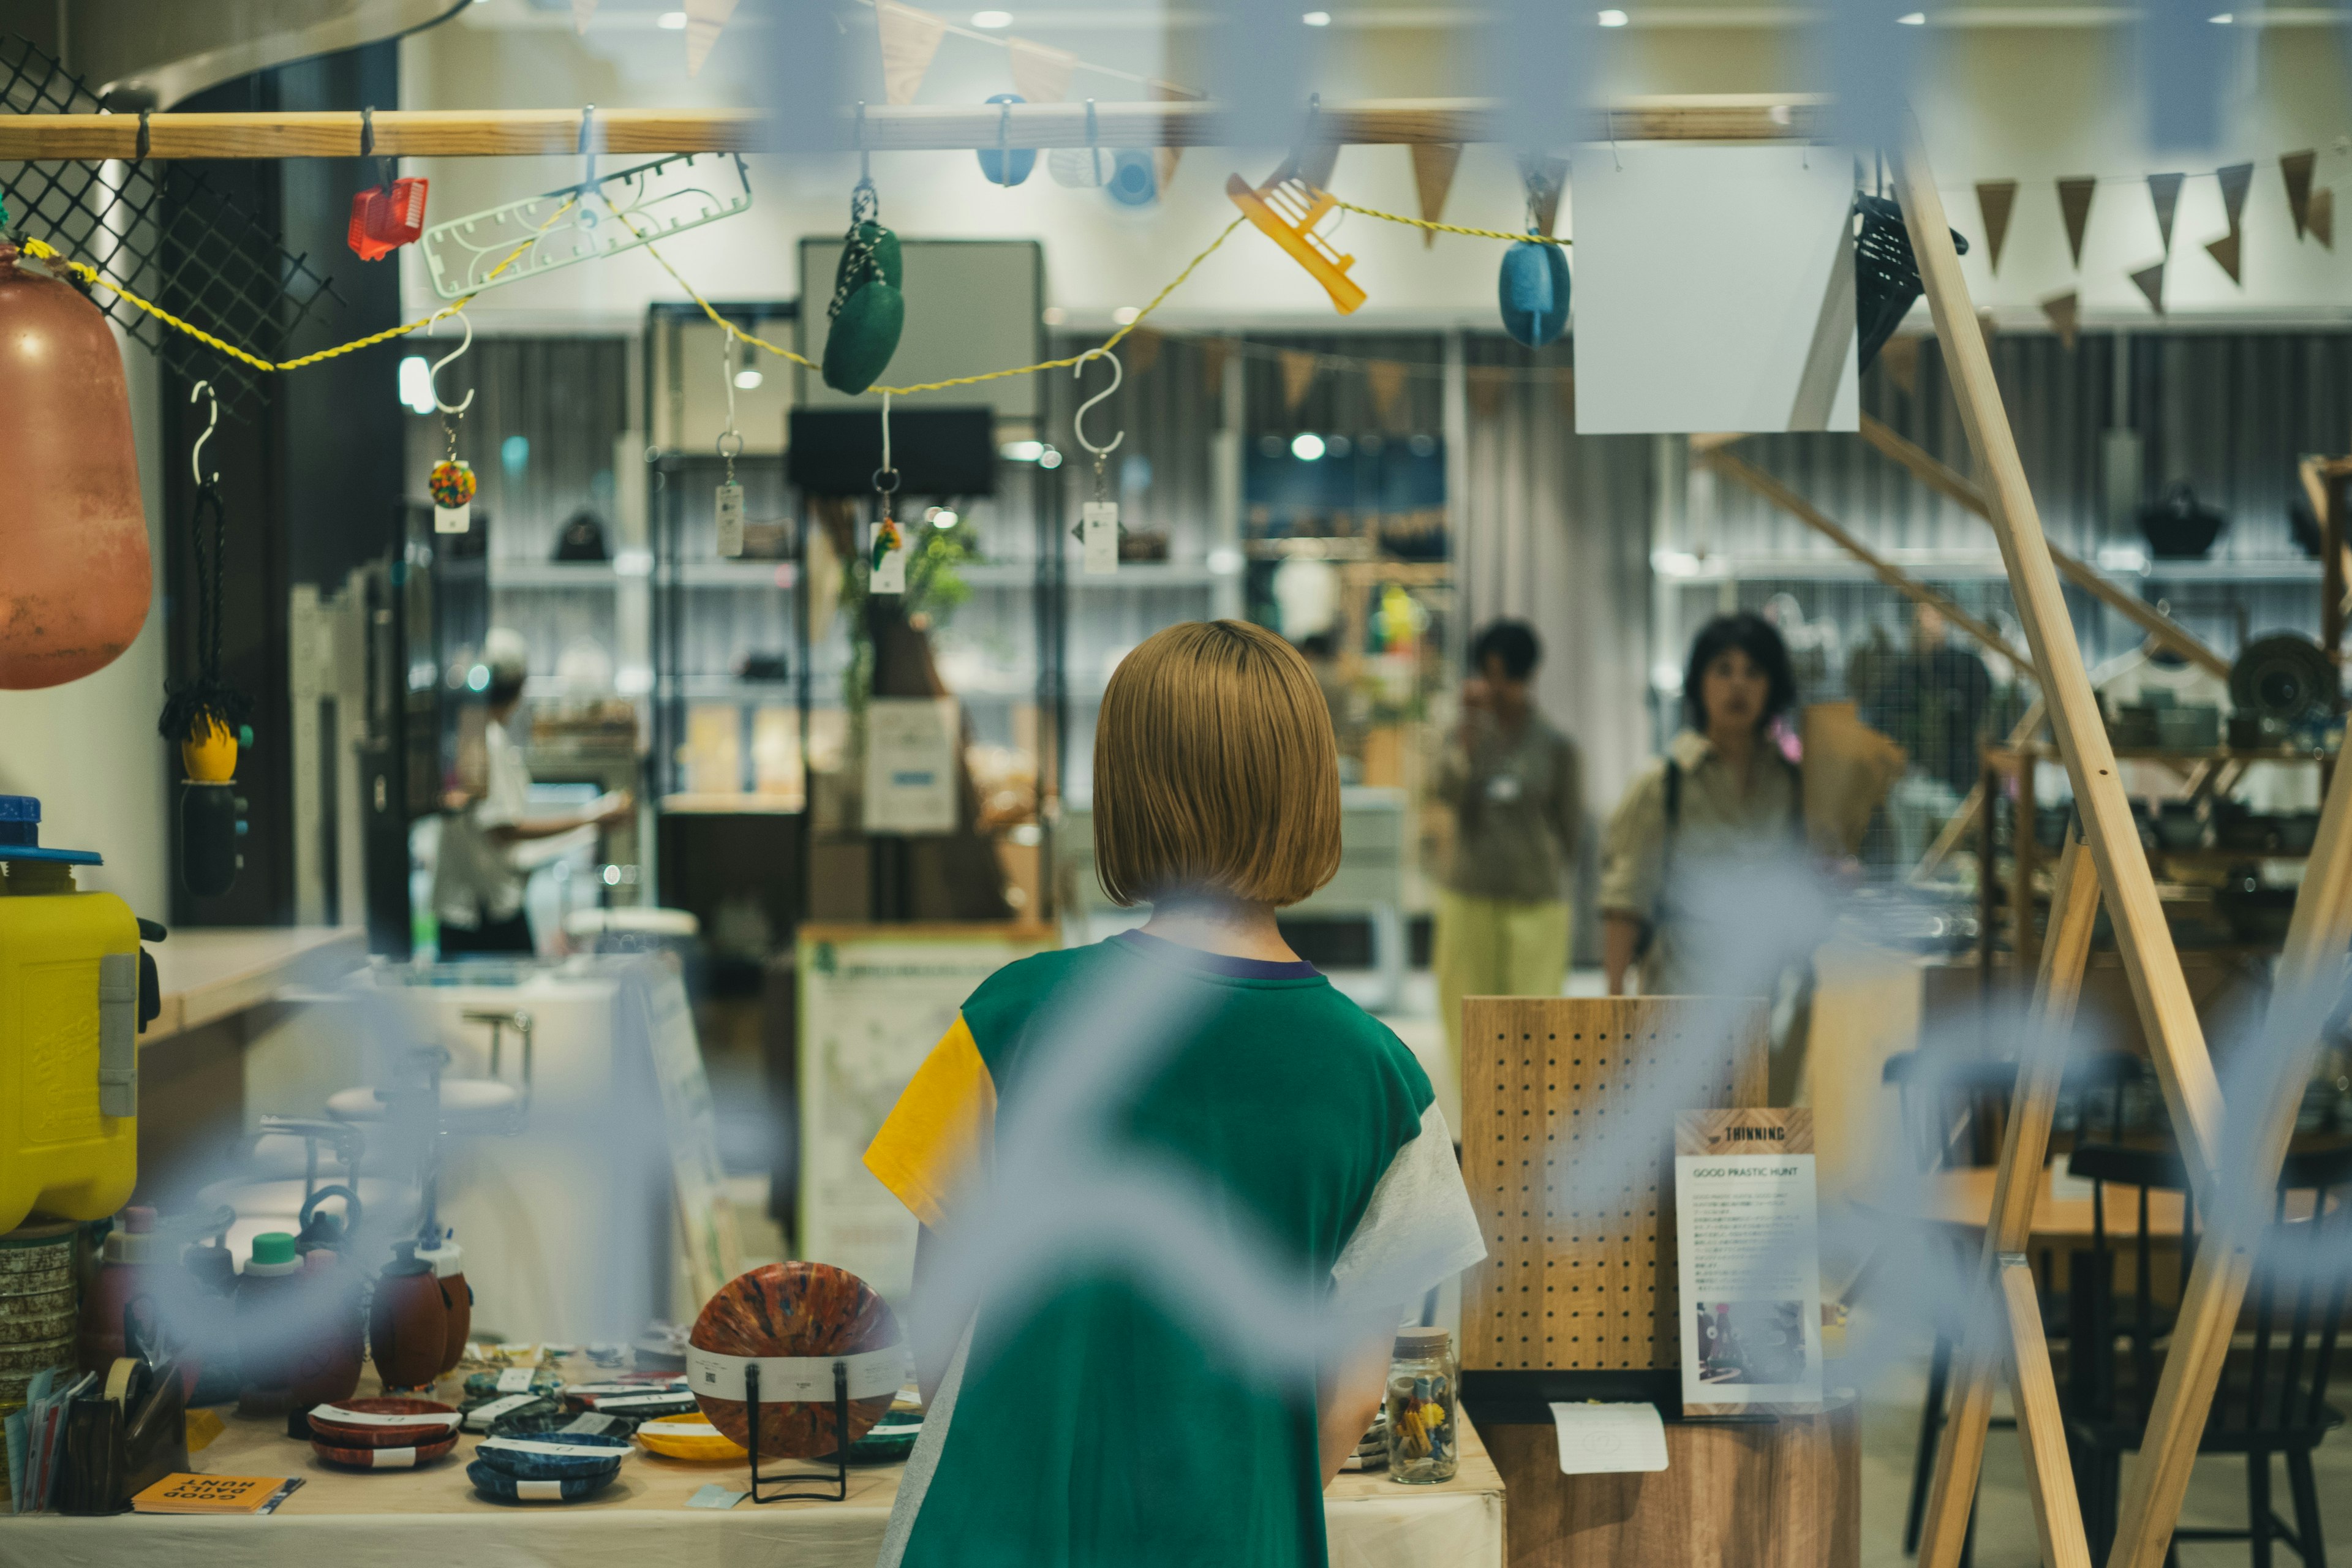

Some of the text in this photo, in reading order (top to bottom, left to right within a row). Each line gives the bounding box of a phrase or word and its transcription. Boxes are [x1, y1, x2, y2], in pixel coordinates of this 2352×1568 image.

[1726, 1126, 1785, 1140] THINNING
[1694, 1167, 1798, 1177] GOOD PRASTIC HUNT
[164, 1491, 236, 1500] GOOD
